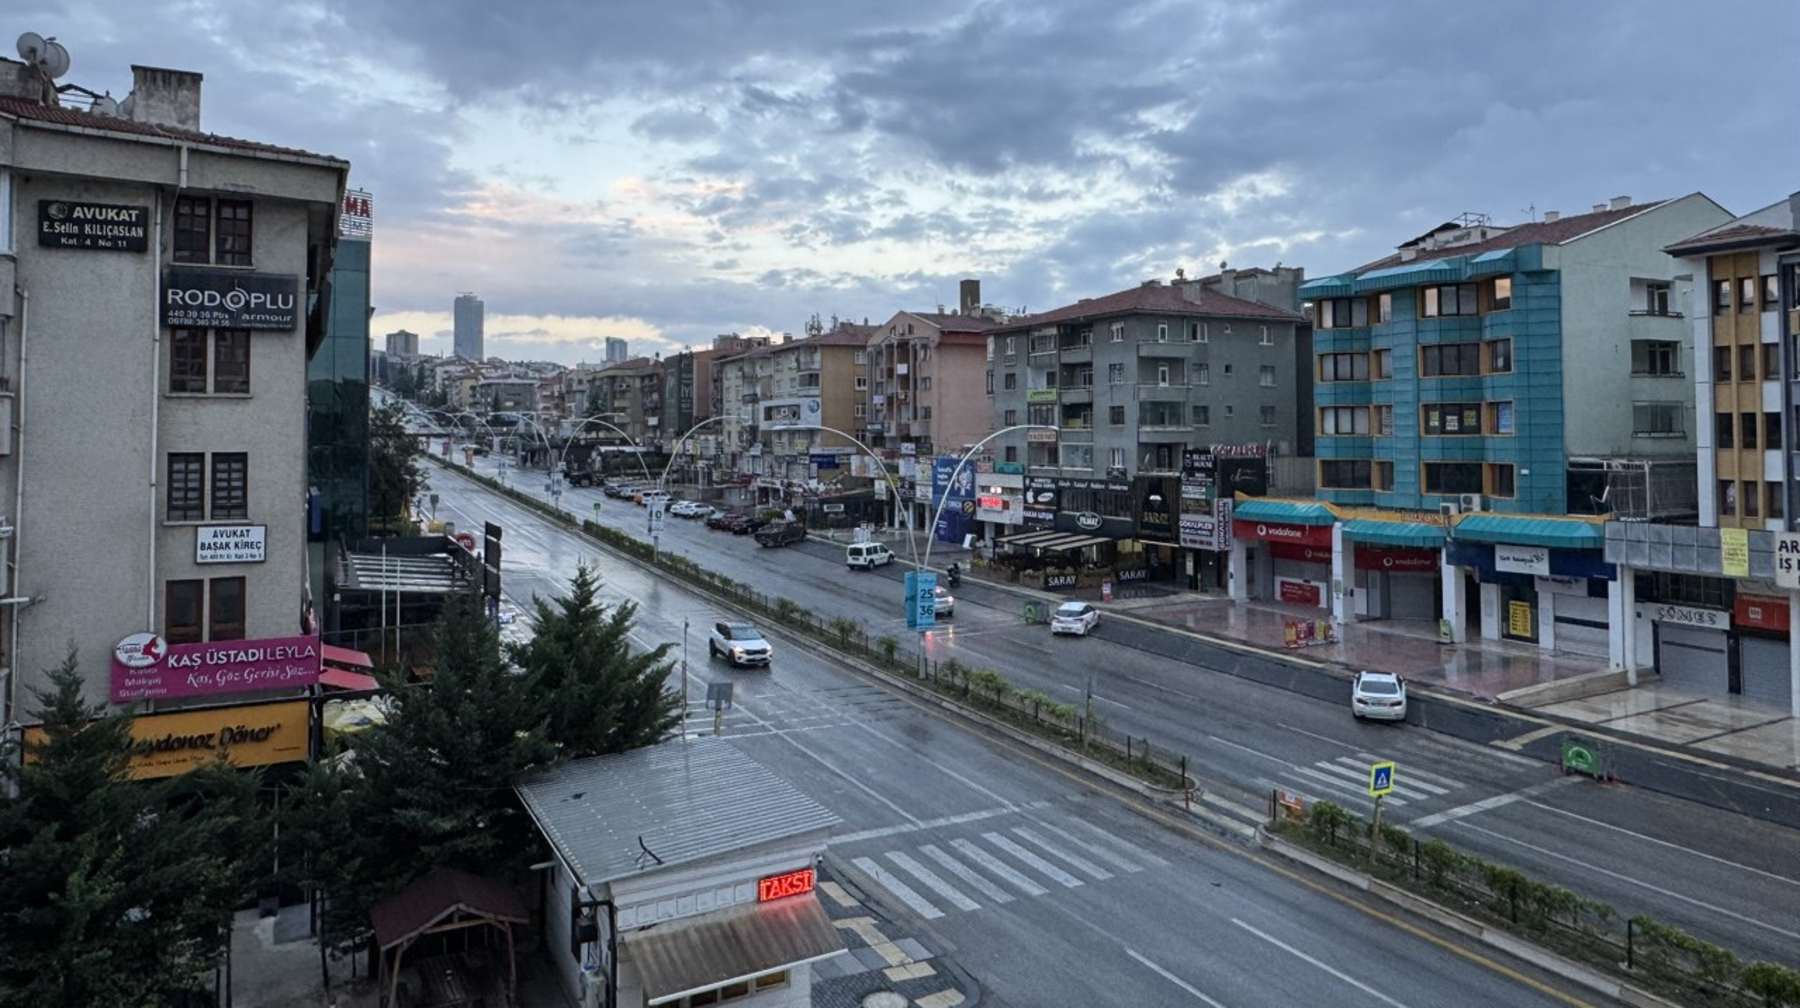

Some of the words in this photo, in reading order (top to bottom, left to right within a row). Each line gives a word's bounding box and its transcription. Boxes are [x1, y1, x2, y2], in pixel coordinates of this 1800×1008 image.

[73, 206, 139, 222] AVUKAT
[84, 223, 143, 240] KILIÇASLAN
[85, 238, 91, 246] 4
[167, 287, 293, 310] RODOPLU
[241, 313, 292, 322] armour
[212, 529, 251, 538] AVUKAT
[1268, 527, 1302, 538] vodafone
[200, 542, 231, 553] BAŞAK
[234, 540, 262, 551] KİREÇ
[1779, 554, 1792, 574] İŞ
[1048, 574, 1077, 586] SARAY
[1120, 570, 1147, 580] SARAY
[920, 589, 934, 599] 25
[919, 605, 934, 616] 36
[168, 653, 202, 670] KAŞ
[206, 648, 264, 666] ÜSTADI
[266, 645, 315, 661] LEYLA
